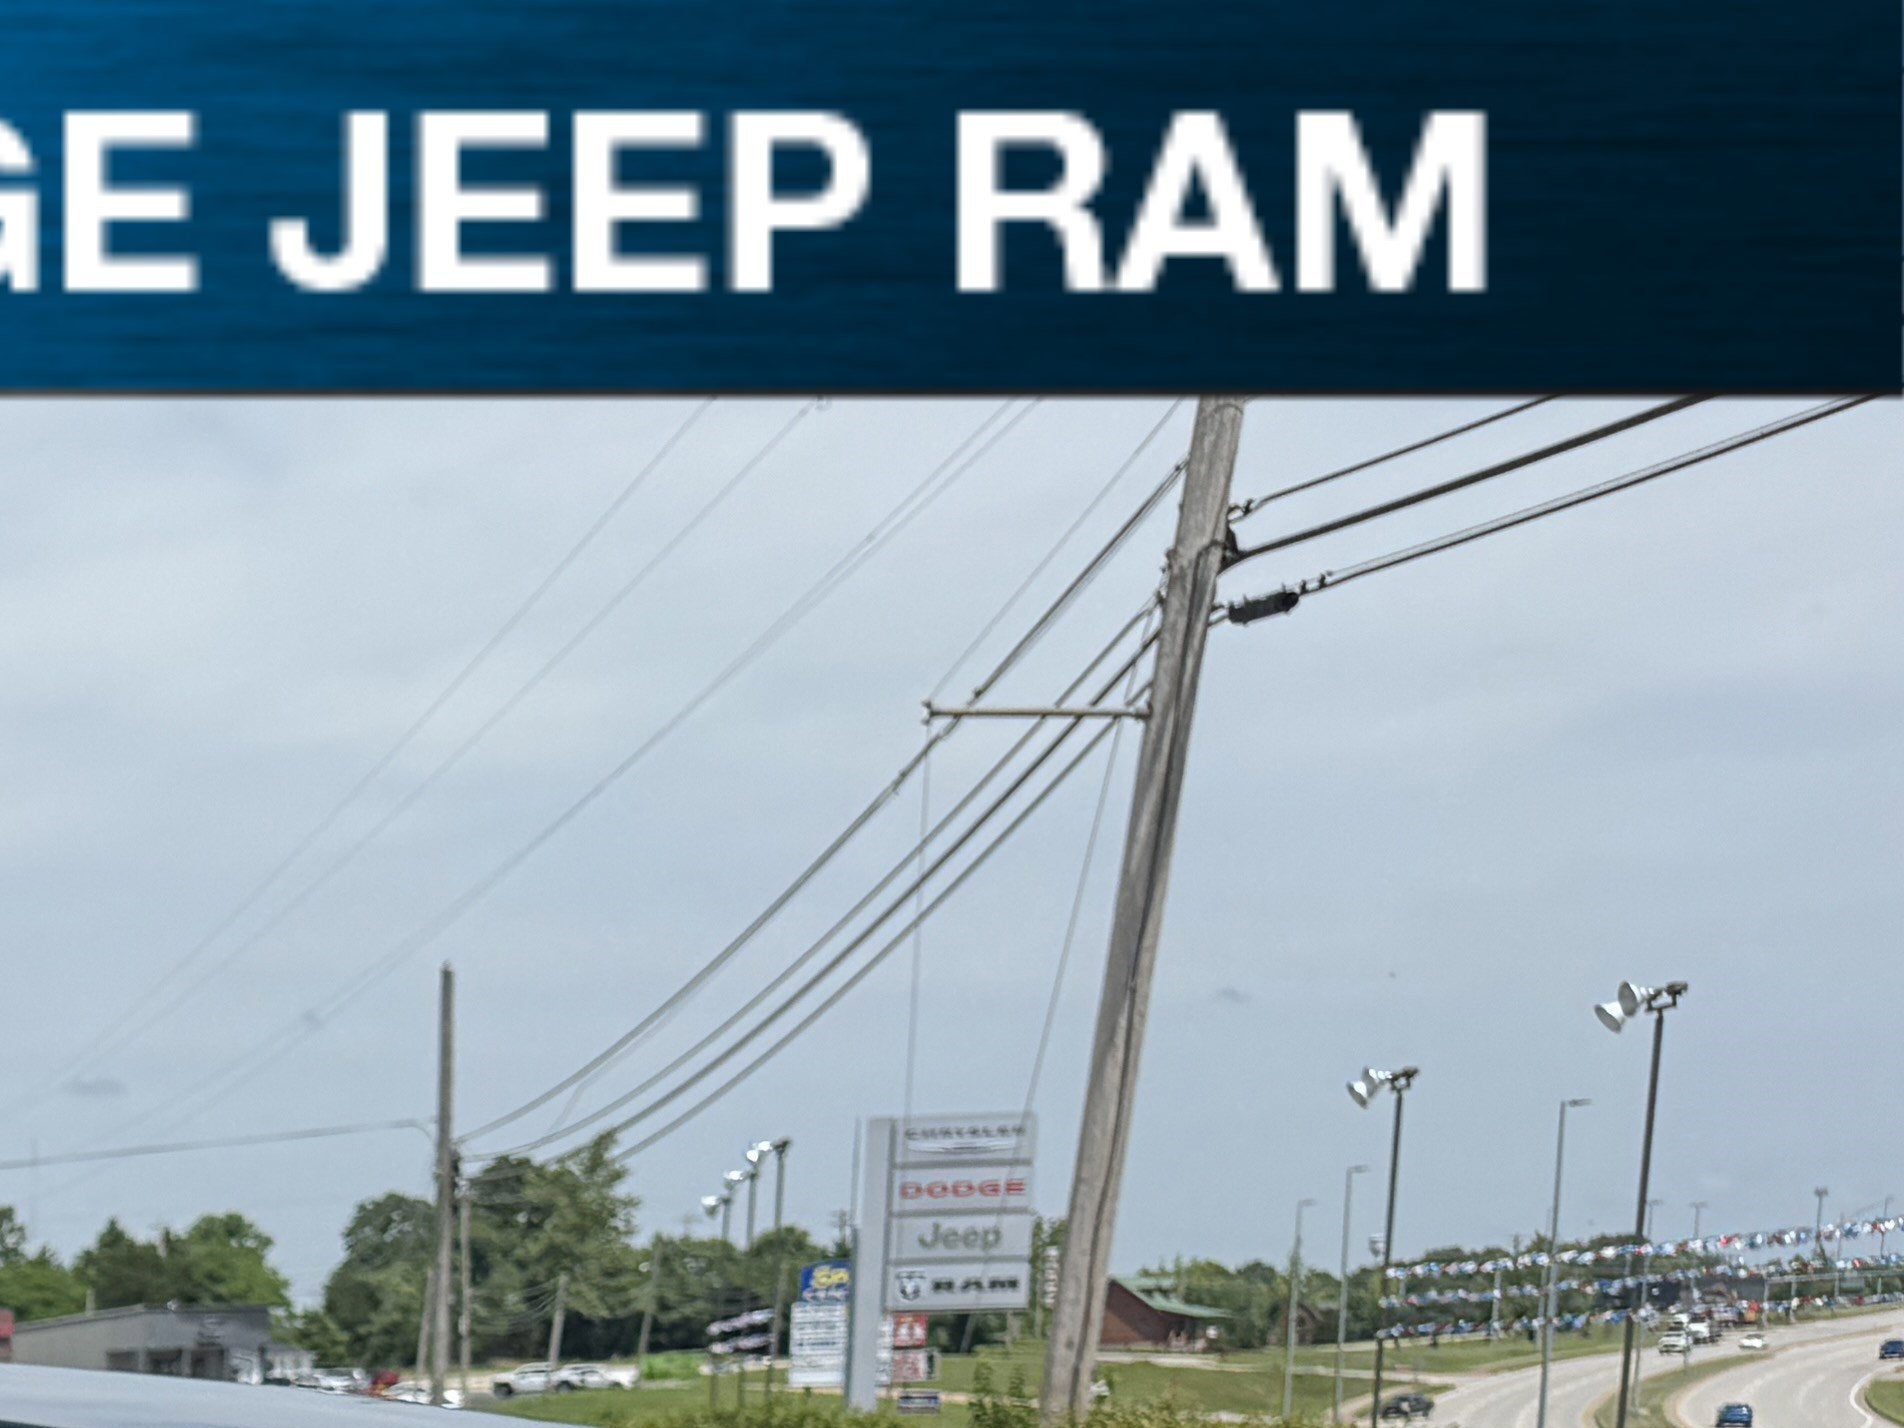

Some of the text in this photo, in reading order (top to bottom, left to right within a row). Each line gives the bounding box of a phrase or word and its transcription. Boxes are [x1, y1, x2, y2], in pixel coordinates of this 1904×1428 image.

[900, 1178, 1027, 1200] DODGE
[917, 1222, 1003, 1251] Jeep
[932, 1277, 1020, 1294] RAM
